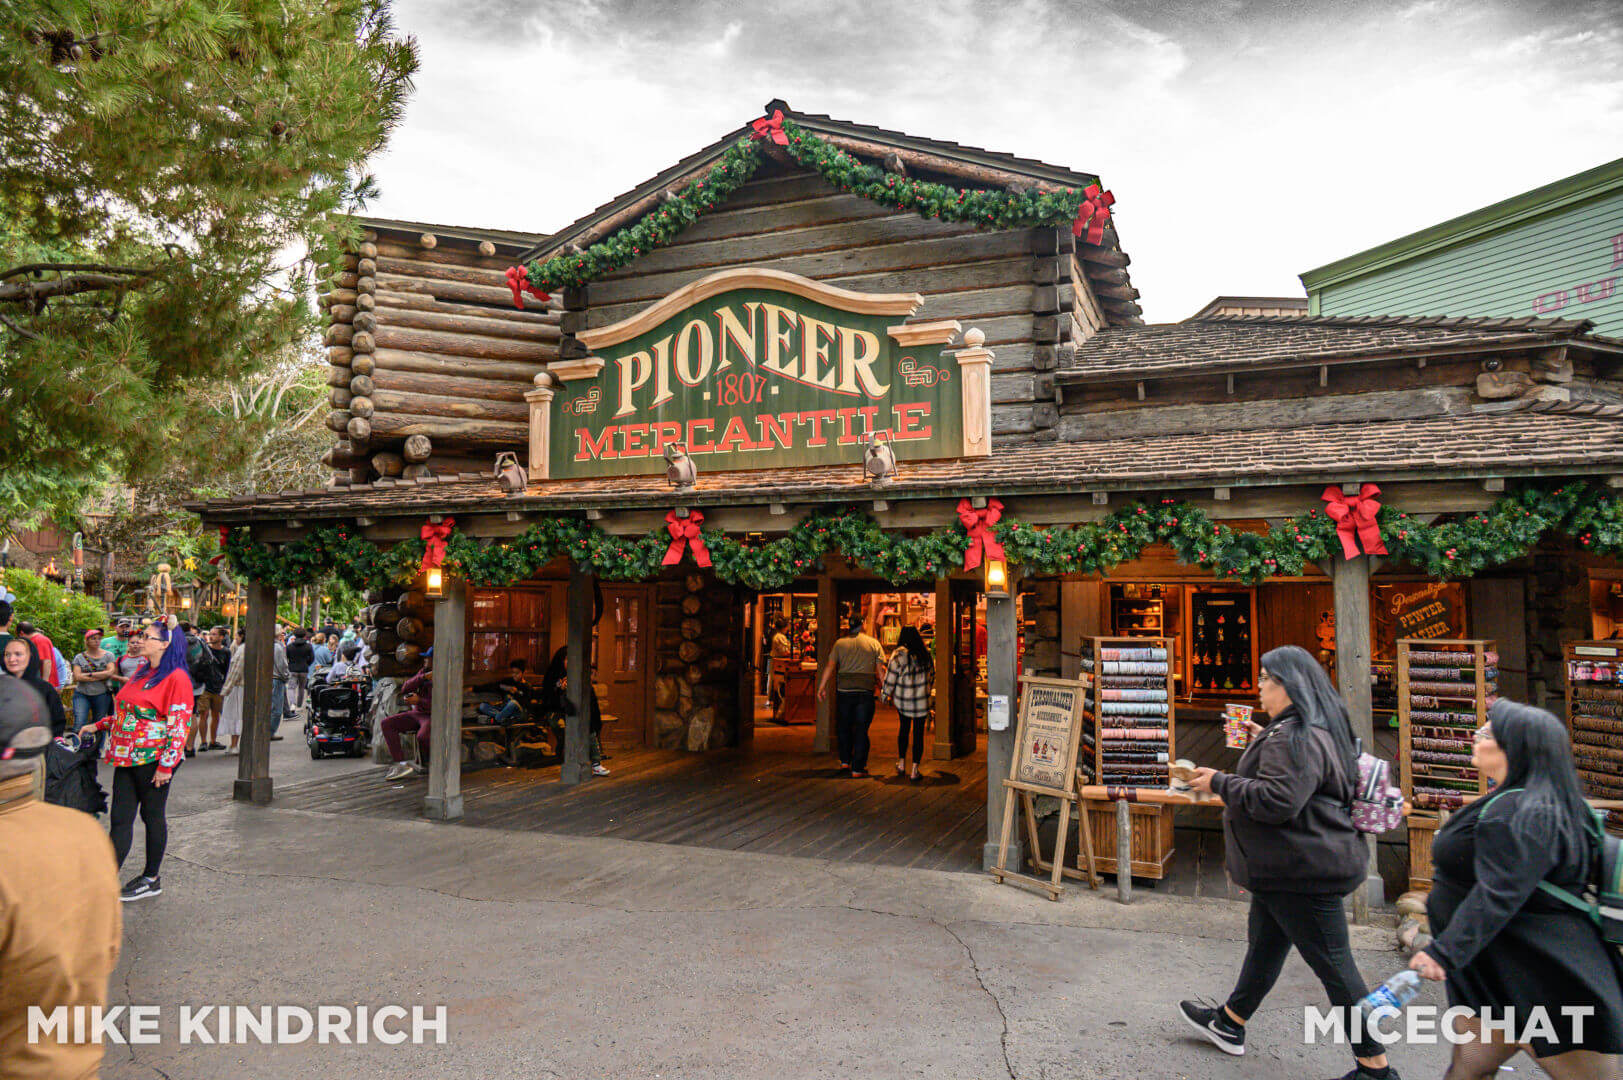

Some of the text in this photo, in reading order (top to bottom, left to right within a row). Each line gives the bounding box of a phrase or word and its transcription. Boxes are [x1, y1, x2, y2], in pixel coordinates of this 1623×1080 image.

[611, 302, 891, 419] PIONEER
[715, 373, 768, 406] 1807
[573, 401, 933, 462] MERCANTILE
[1400, 601, 1446, 628] PEWTER
